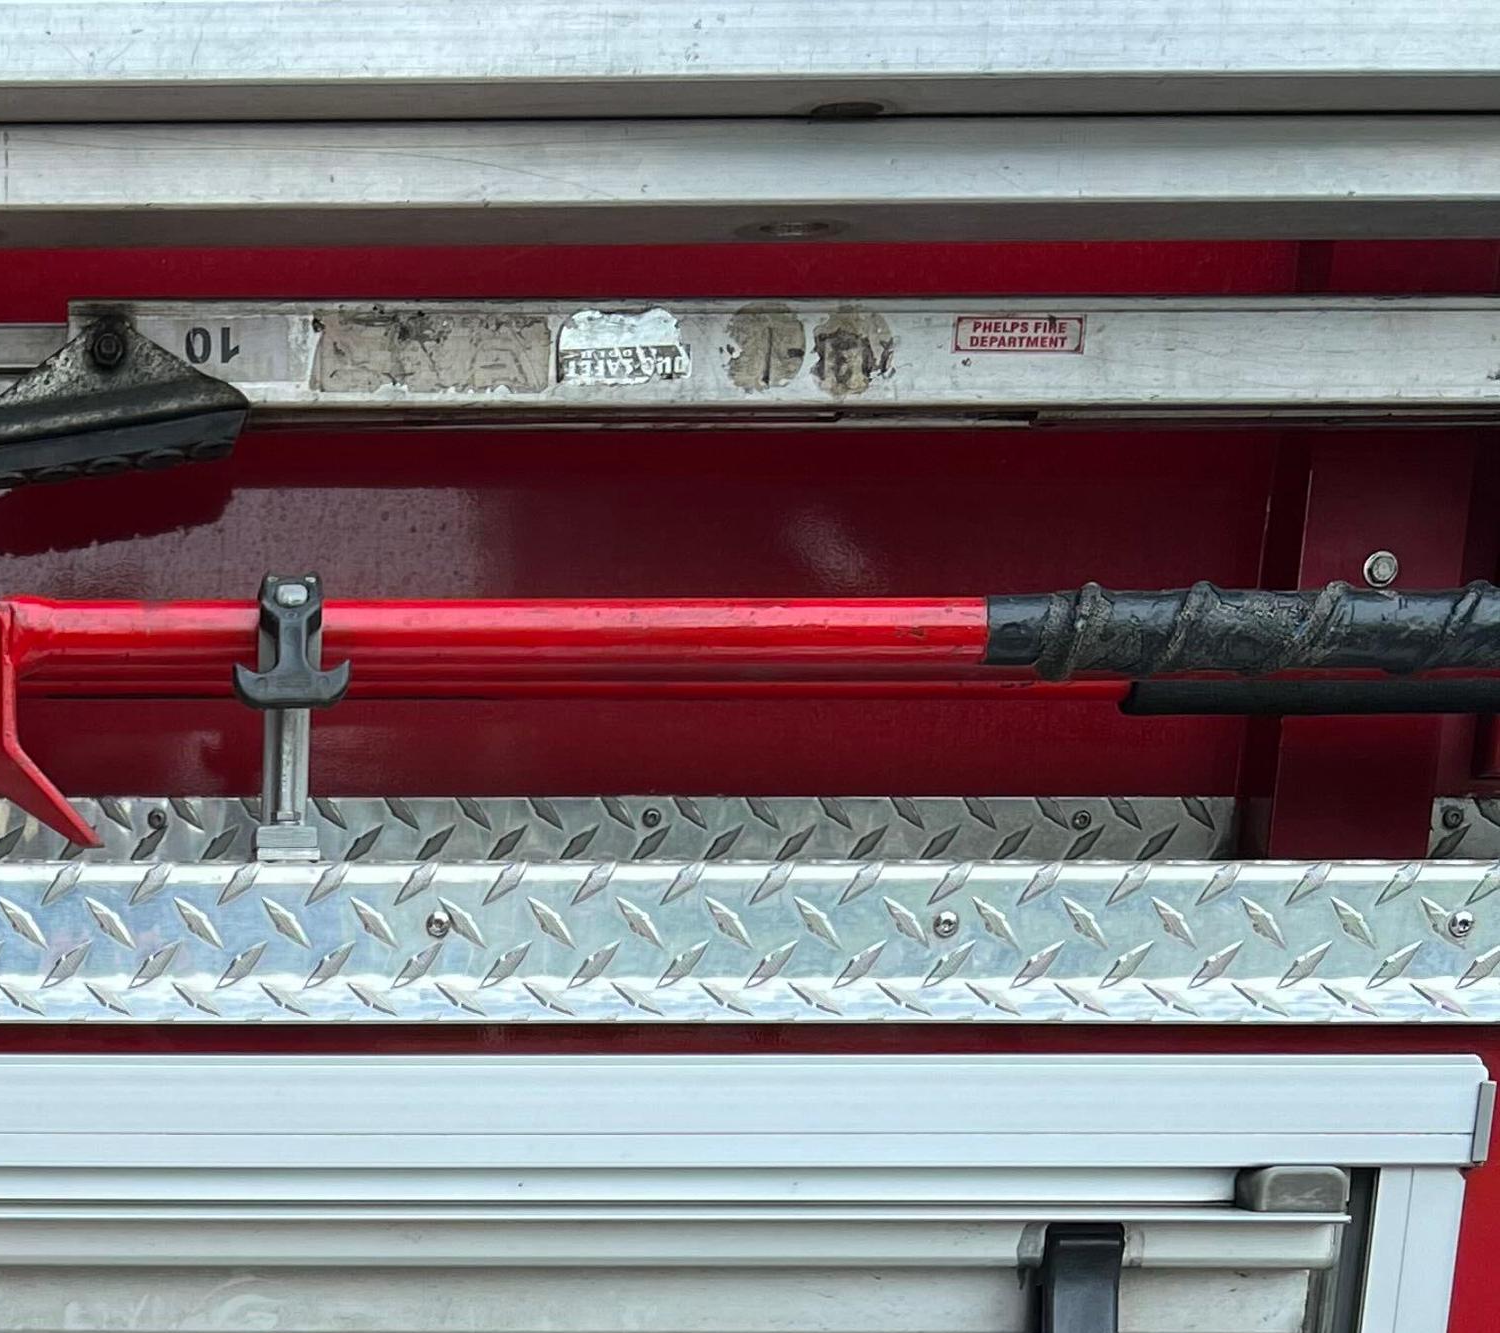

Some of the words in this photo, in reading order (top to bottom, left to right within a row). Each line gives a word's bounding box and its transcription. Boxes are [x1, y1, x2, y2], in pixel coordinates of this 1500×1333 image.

[972, 321, 1029, 334] PHELPS
[1033, 322, 1068, 334] FIRE
[185, 327, 240, 364] 10
[969, 335, 1068, 348] DEPARTMENT
